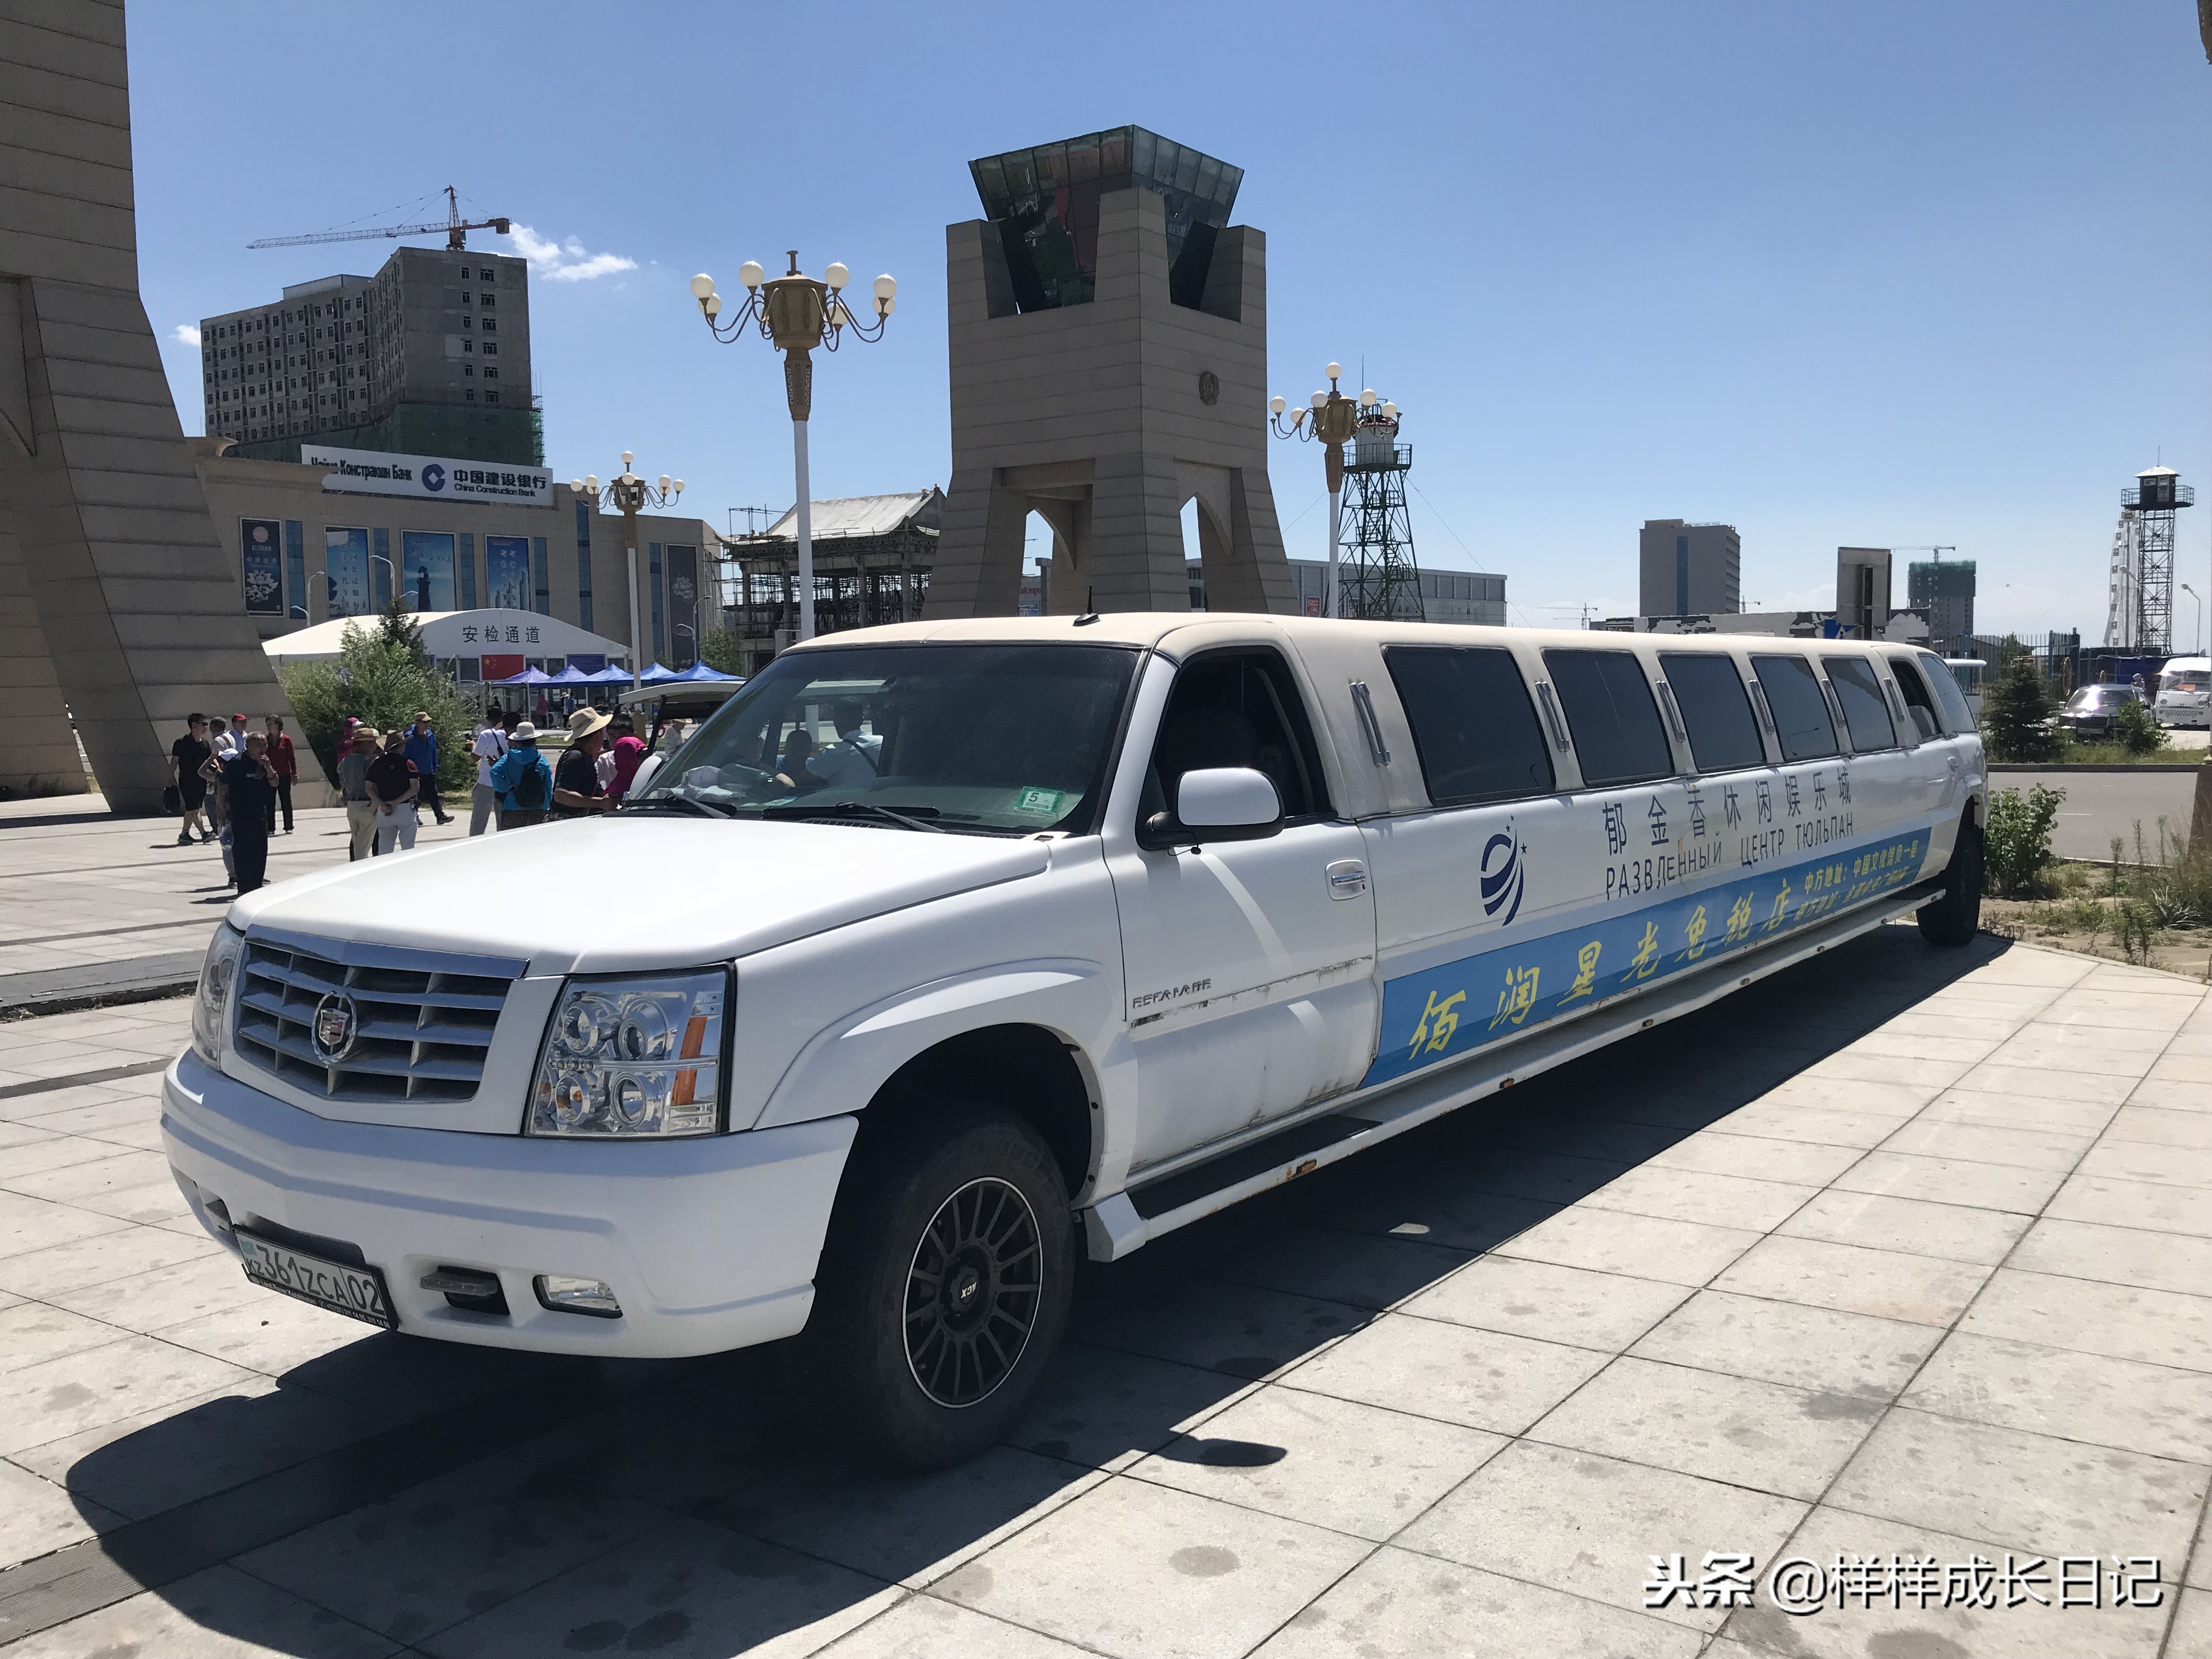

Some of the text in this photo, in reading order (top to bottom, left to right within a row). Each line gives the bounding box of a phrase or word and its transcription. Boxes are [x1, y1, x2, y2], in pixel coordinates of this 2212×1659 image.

[340, 459, 391, 481] Констракшн
[392, 464, 413, 481] Банк
[454, 469, 546, 489] 中国建设银行
[454, 483, 536, 497] China Construction Bank
[462, 625, 540, 643] 安检通道
[1029, 792, 1040, 802] 5
[1602, 765, 1852, 856] 郁金香休闲娱乐城
[1606, 812, 1854, 901] РАЗВЛЕННЫЙ ЦЕНТР ТЮЛЬПАН
[1408, 877, 1792, 1060] 佰润星光免税店
[246, 1258, 264, 1276] KZ
